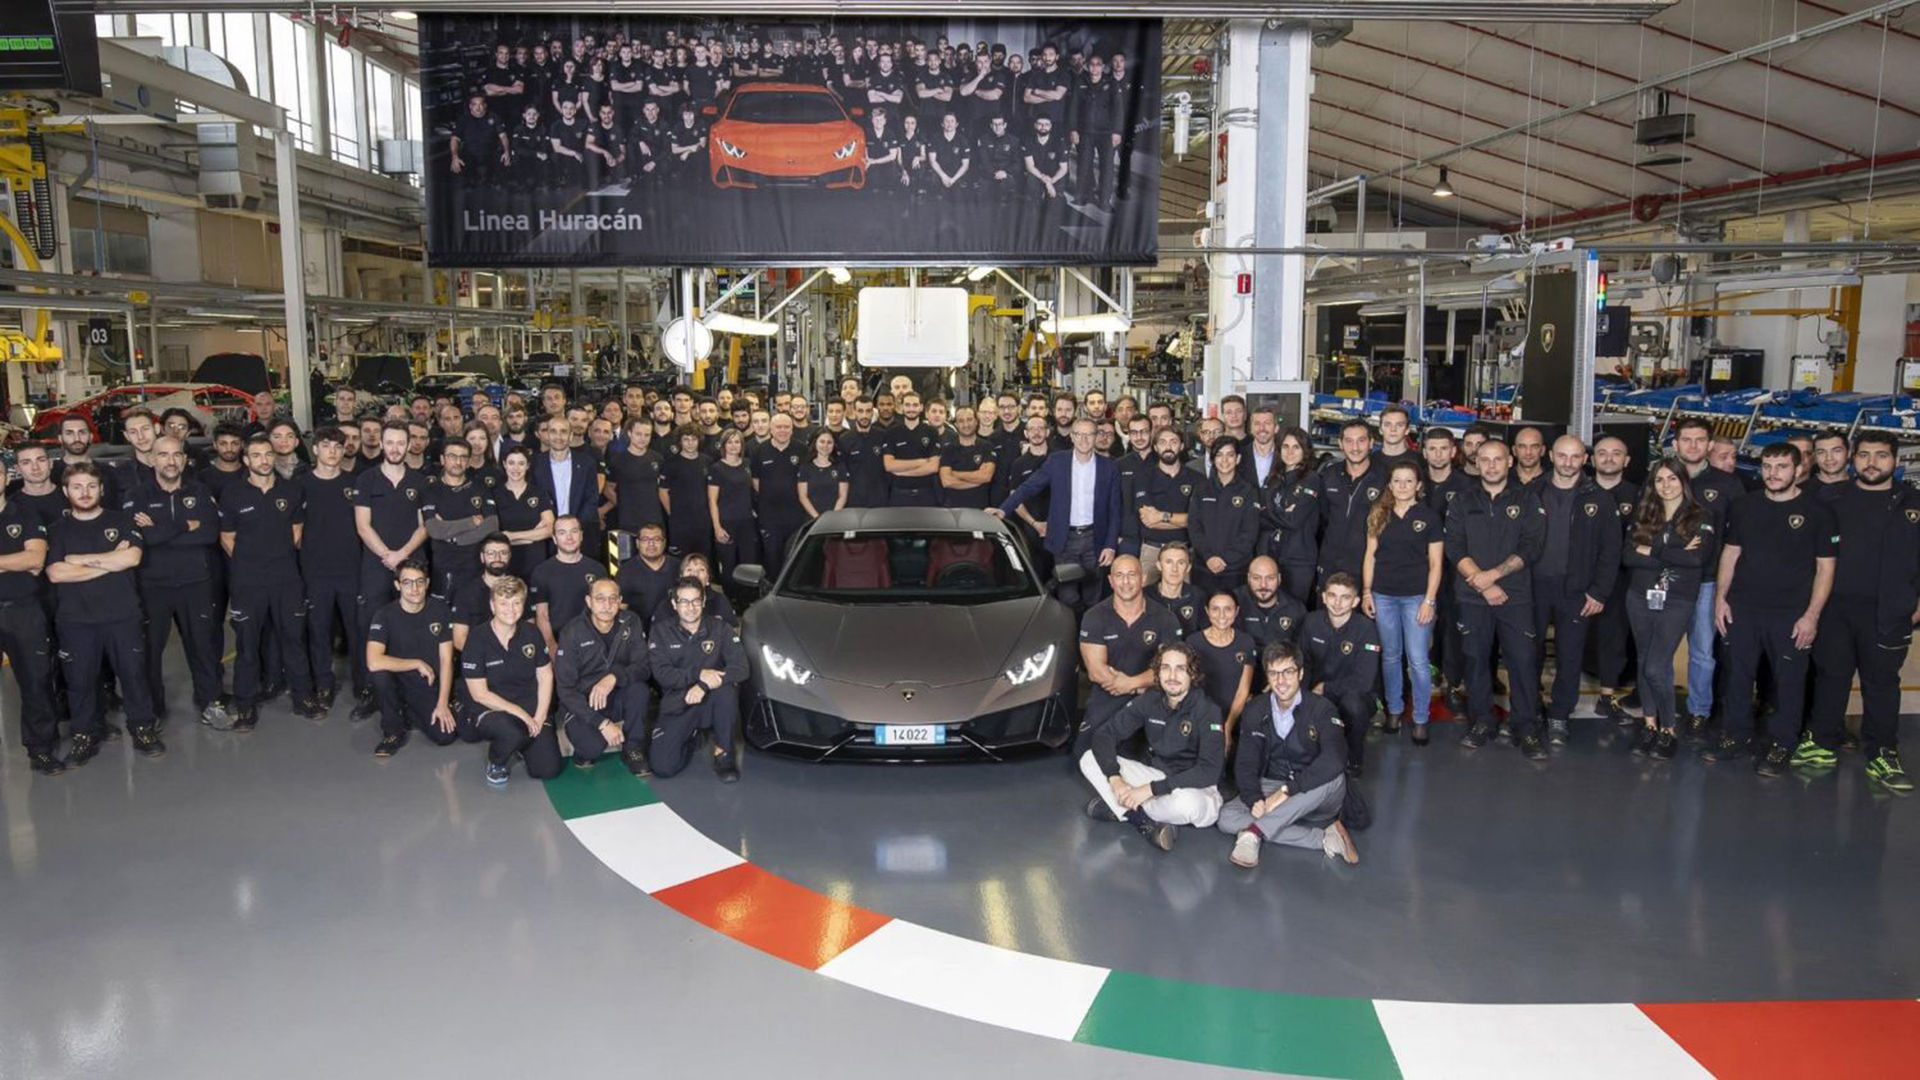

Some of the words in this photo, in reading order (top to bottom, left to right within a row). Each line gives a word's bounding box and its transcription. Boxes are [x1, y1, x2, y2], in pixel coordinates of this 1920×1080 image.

[463, 209, 530, 231] Linea
[539, 207, 643, 231] Huracán
[91, 328, 108, 343] 03
[893, 728, 928, 741] 14022
